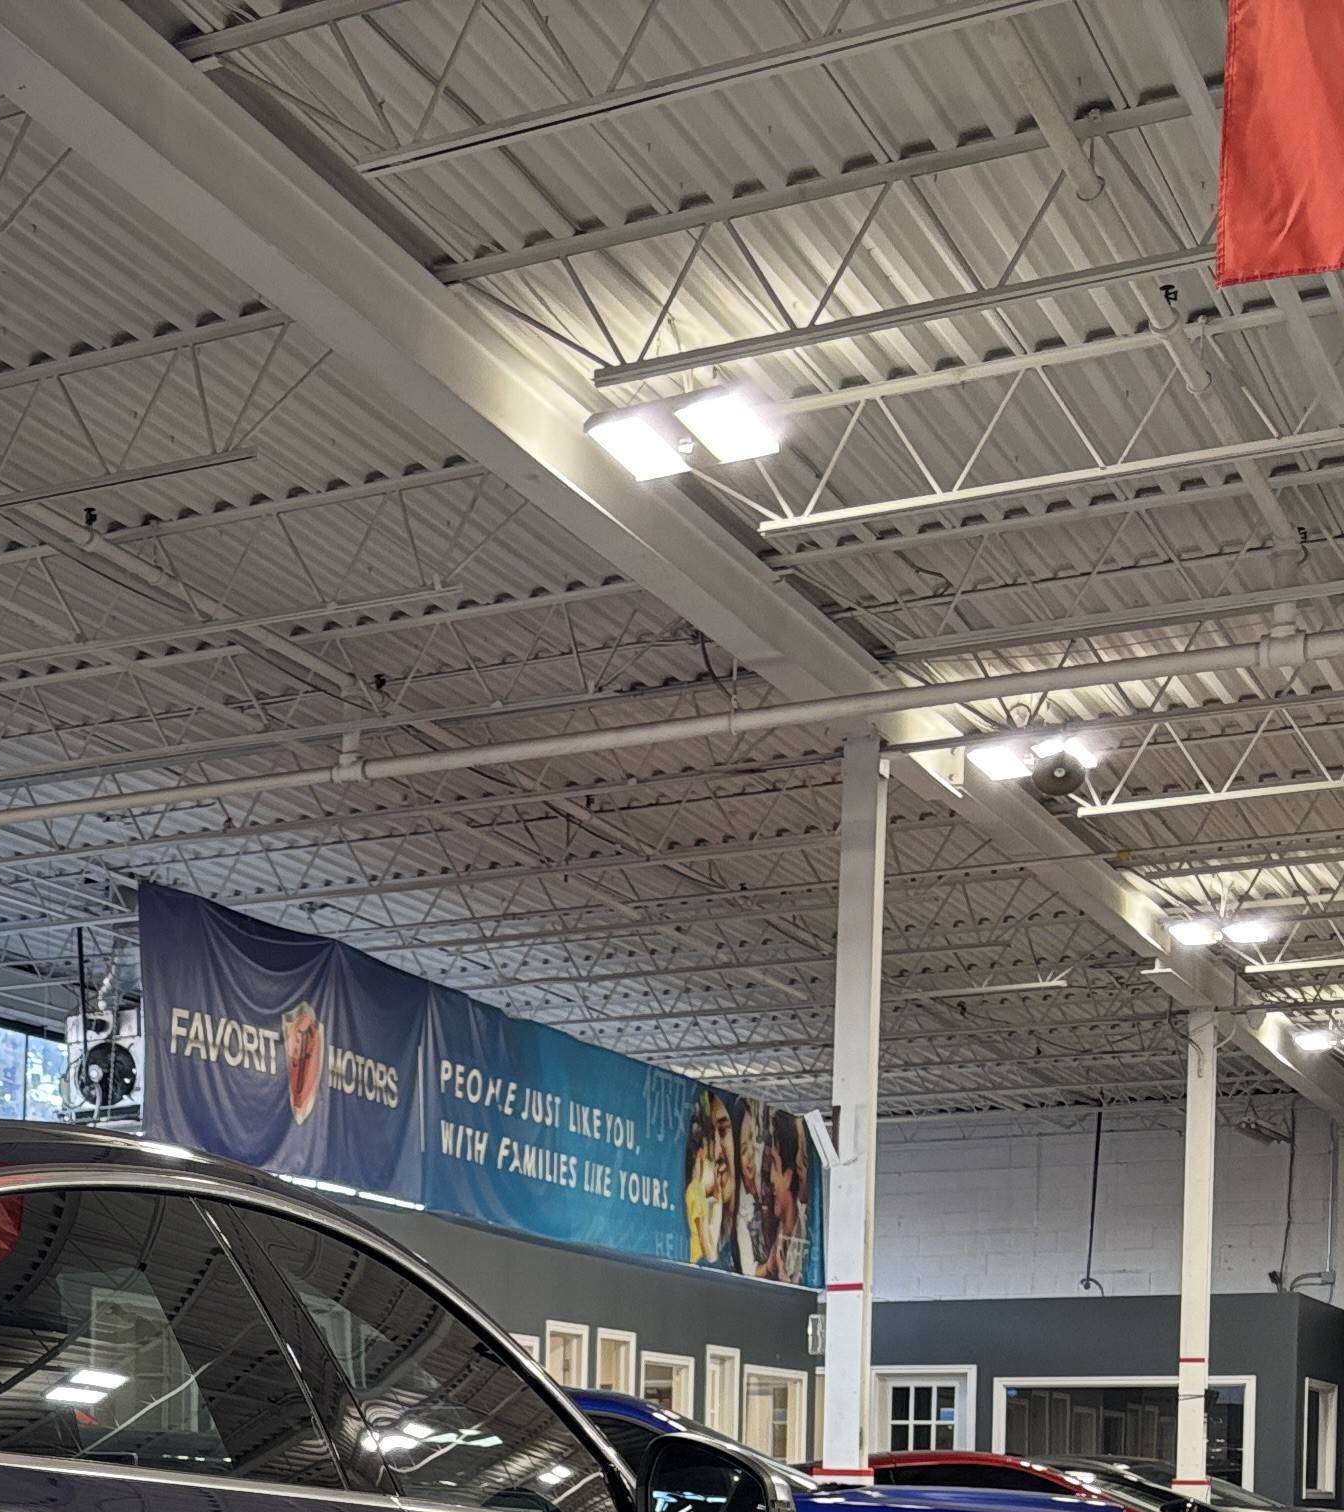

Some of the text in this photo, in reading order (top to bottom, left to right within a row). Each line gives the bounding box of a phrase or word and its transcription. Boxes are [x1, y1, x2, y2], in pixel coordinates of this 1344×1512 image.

[170, 1007, 399, 1109] FAVORIT MOTORS
[440, 1119, 675, 1211] WITH FAMILIES LIKE YOURS.
[521, 1087, 561, 1128] JUST
[569, 1100, 601, 1139] LIKE
[605, 1112, 640, 1155] YOU,
